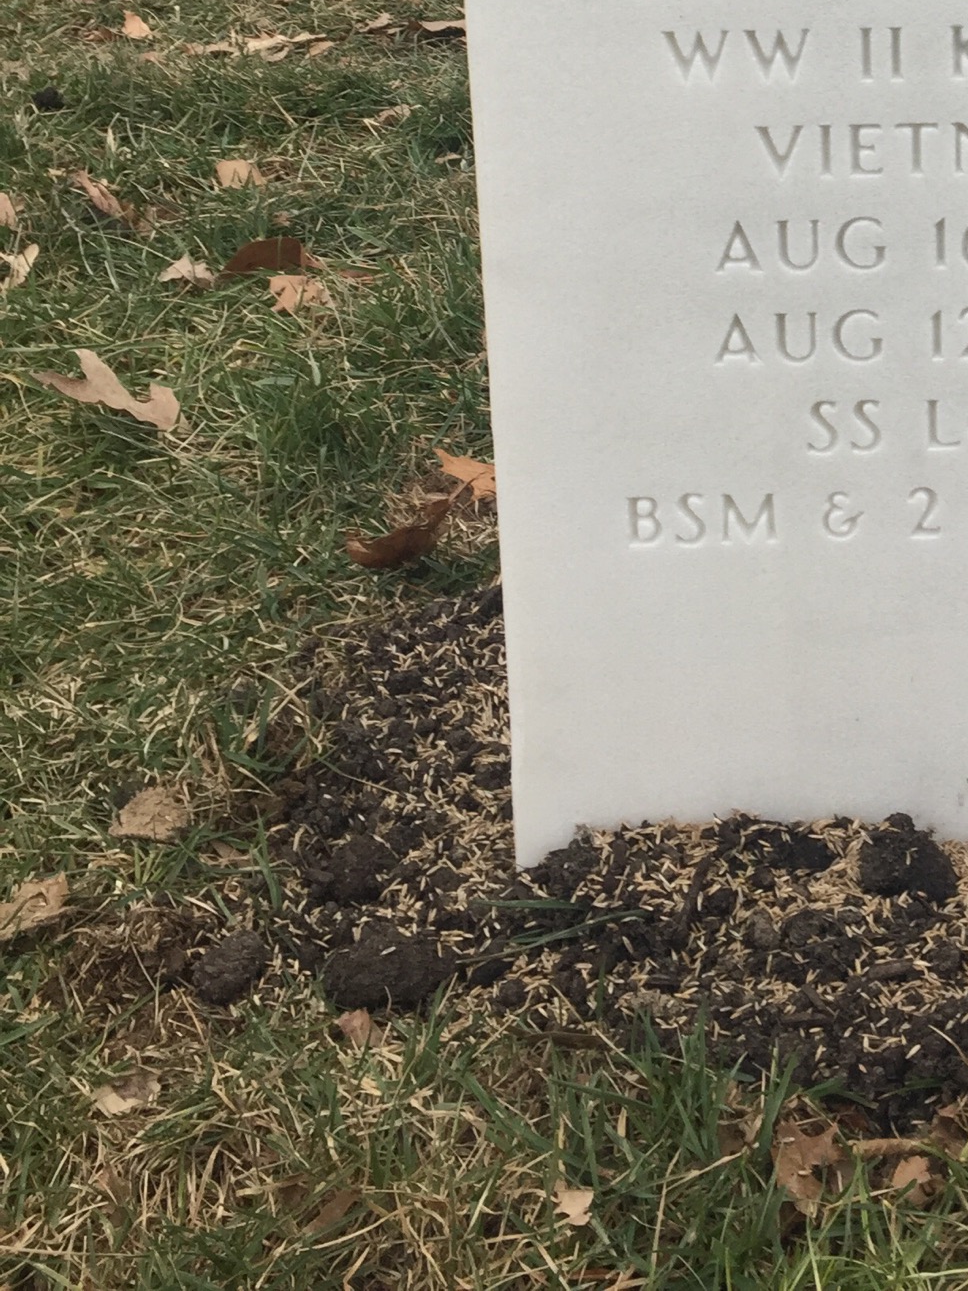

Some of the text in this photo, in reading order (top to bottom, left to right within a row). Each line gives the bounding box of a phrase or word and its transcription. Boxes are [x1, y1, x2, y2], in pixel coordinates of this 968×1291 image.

[661, 28, 810, 82] WW
[859, 27, 903, 81] II
[715, 216, 887, 273] AUG
[714, 309, 884, 366] AUG
[807, 399, 883, 454] SS
[626, 492, 779, 548] BSM
[822, 491, 864, 538] &
[908, 487, 942, 538] 2
